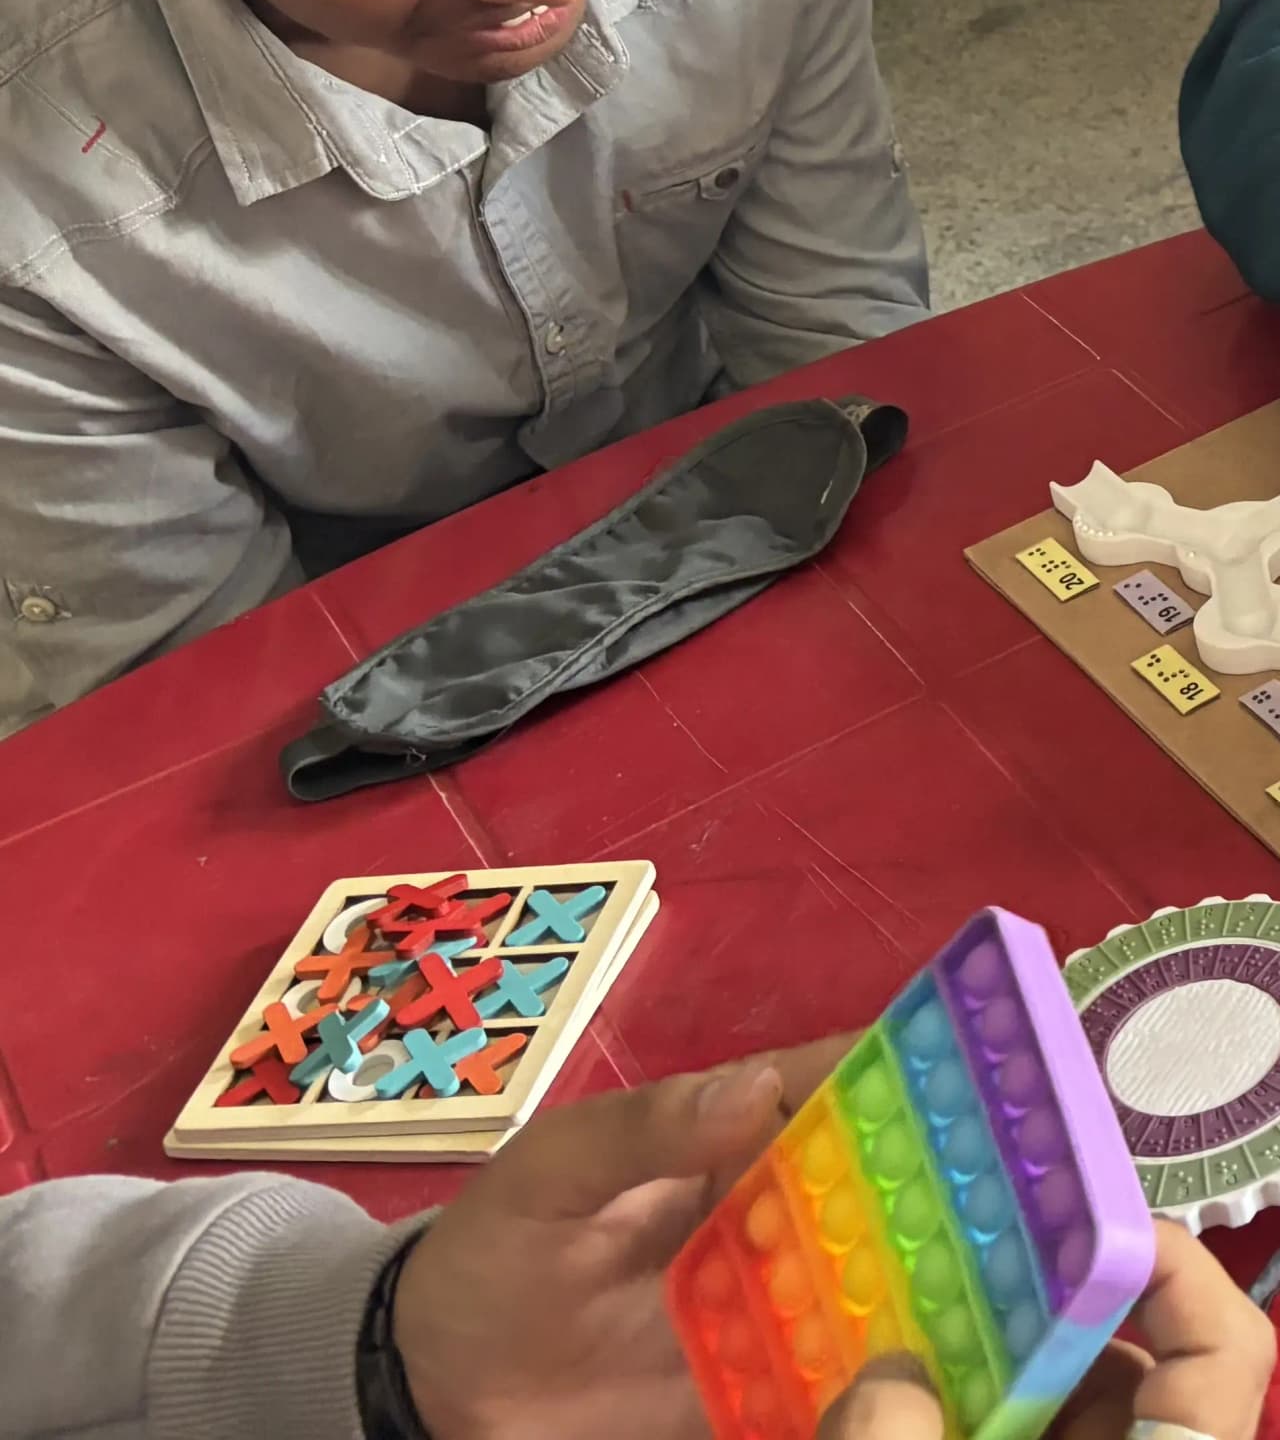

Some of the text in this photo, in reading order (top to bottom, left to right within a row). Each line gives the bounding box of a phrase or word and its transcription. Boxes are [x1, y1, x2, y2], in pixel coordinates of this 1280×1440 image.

[1058, 572, 1085, 591] 20
[1158, 606, 1182, 623] 19
[1179, 681, 1206, 702] 18
